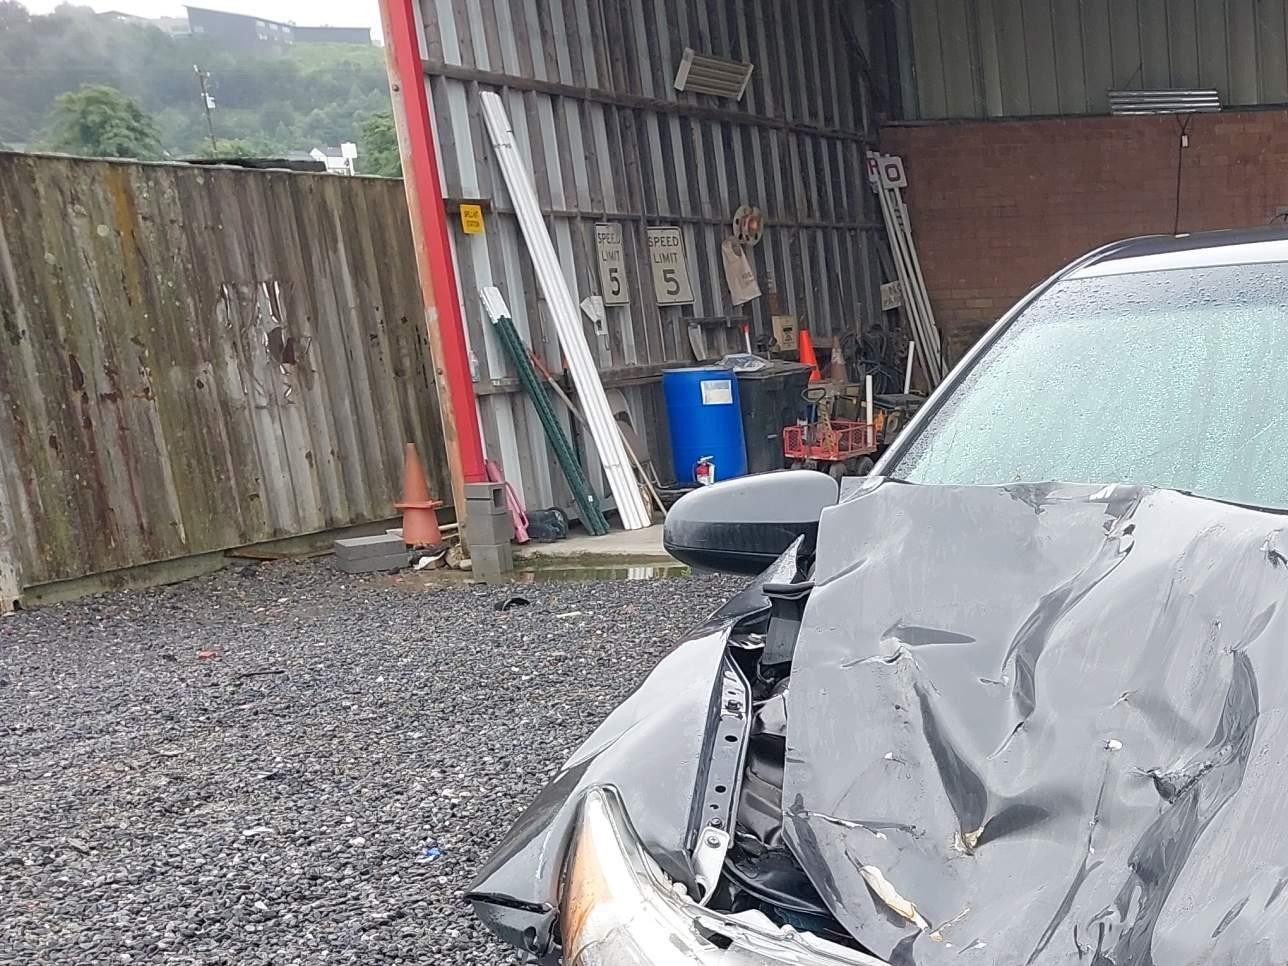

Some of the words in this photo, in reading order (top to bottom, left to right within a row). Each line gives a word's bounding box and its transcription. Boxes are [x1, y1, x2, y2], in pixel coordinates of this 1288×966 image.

[647, 235, 680, 248] SPEED
[601, 250, 620, 262] LIMIT
[653, 251, 678, 264] LIMIT
[608, 267, 621, 296] 5
[662, 268, 681, 296] 5
